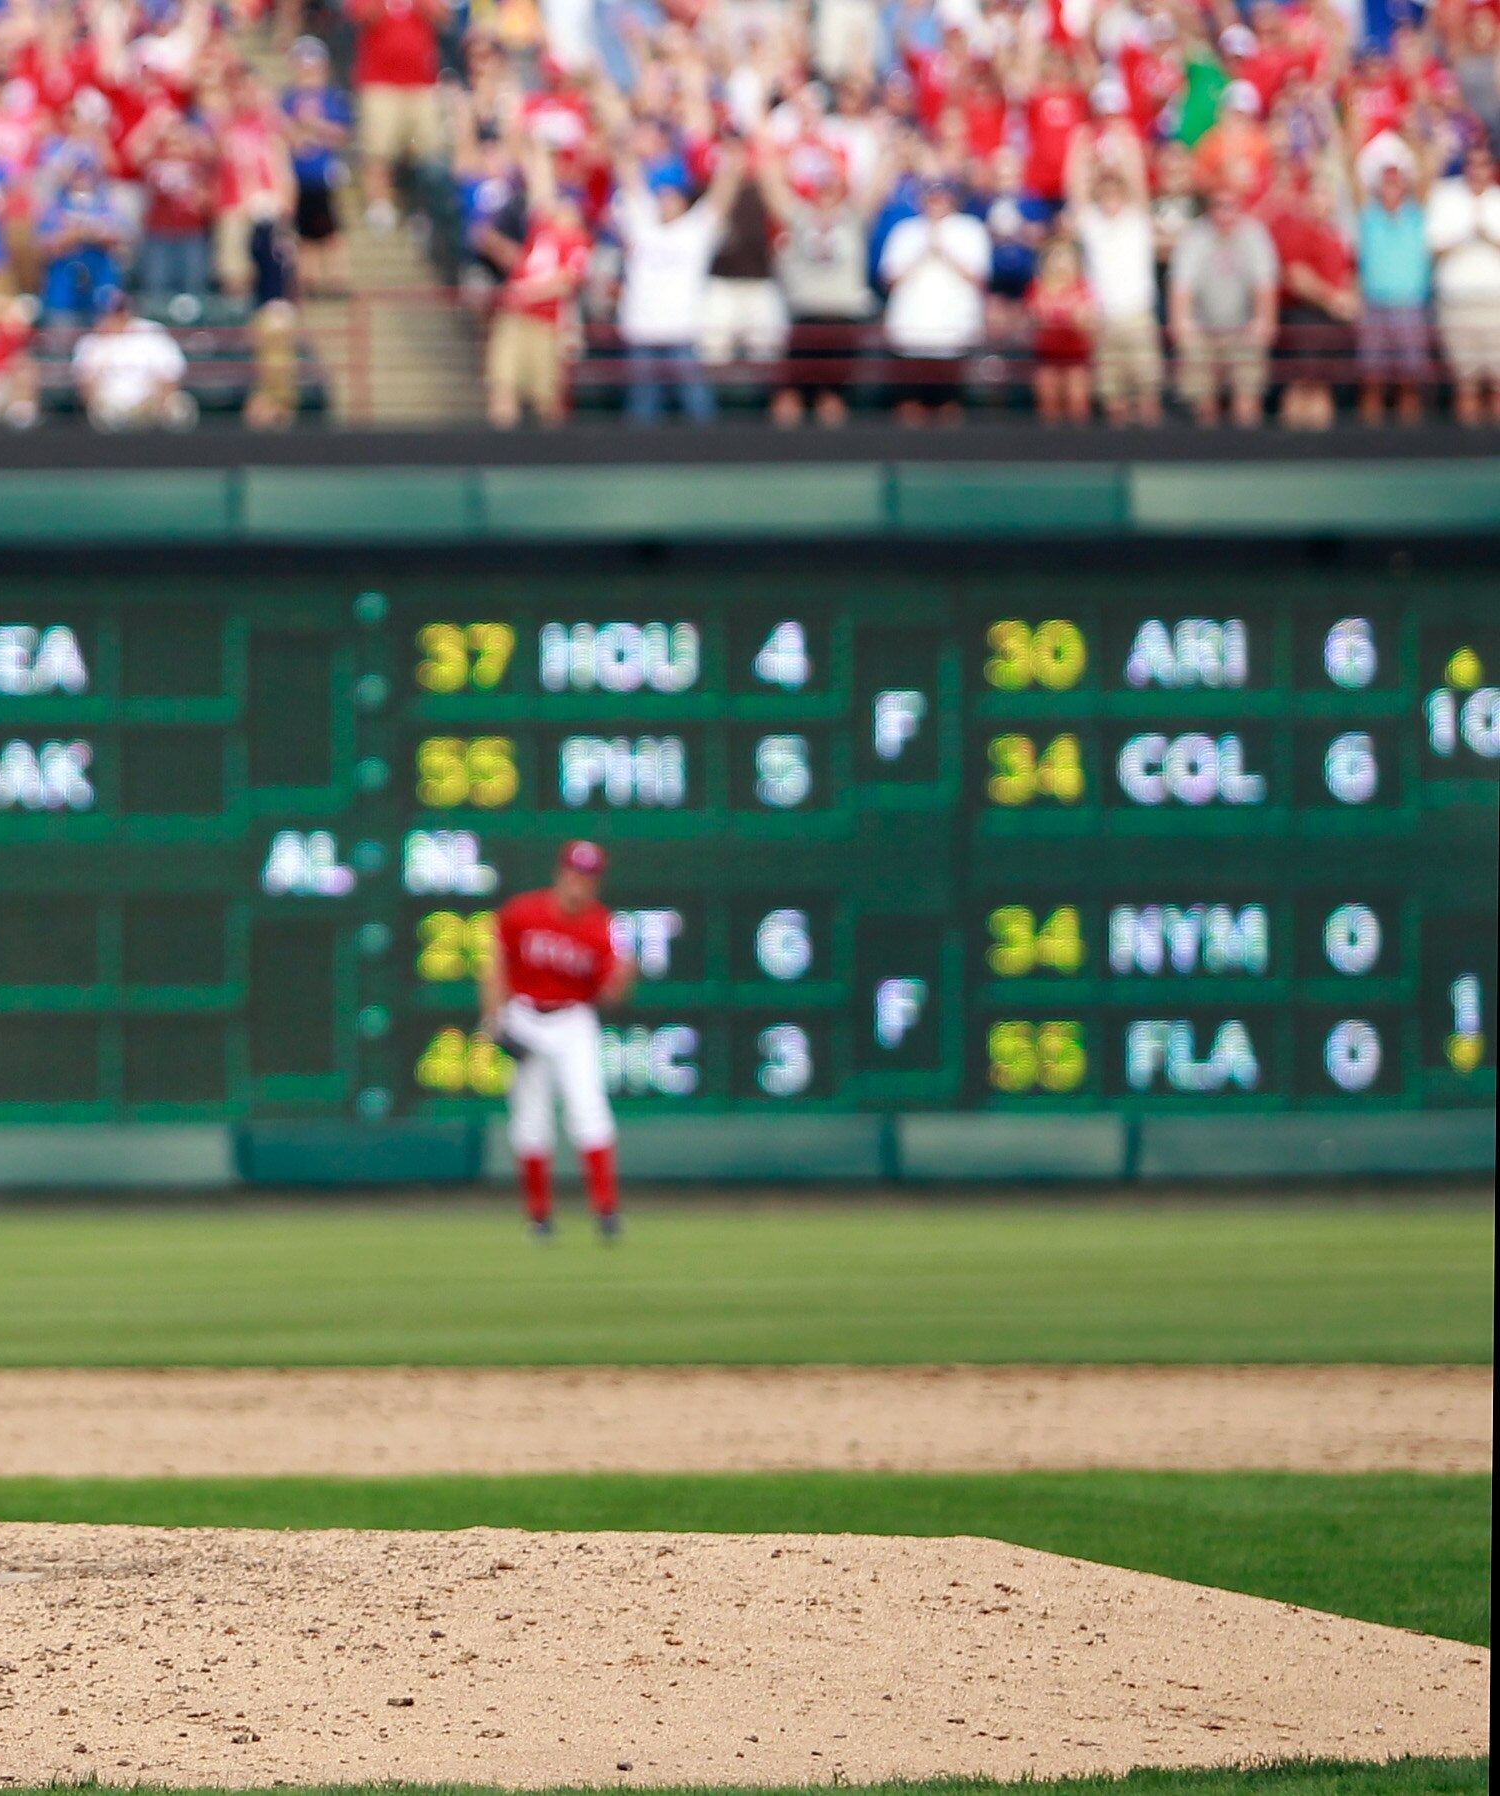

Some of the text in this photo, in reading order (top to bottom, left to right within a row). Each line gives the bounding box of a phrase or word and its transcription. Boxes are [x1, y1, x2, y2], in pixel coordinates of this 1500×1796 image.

[416, 621, 810, 693] 37 HOU 4
[986, 618, 1376, 688] 30 ARI 6
[874, 690, 926, 760] F
[1425, 687, 1498, 757] 10
[418, 736, 810, 807] 55 PHI 5
[988, 732, 1377, 806] 34 COL 6
[756, 909, 811, 977] 6
[988, 903, 1381, 976] 34 NYM 0
[876, 978, 927, 1048] F
[1451, 973, 1480, 1033] 1
[758, 1024, 811, 1094] 3
[989, 1019, 1381, 1089] 55 FLA 0
